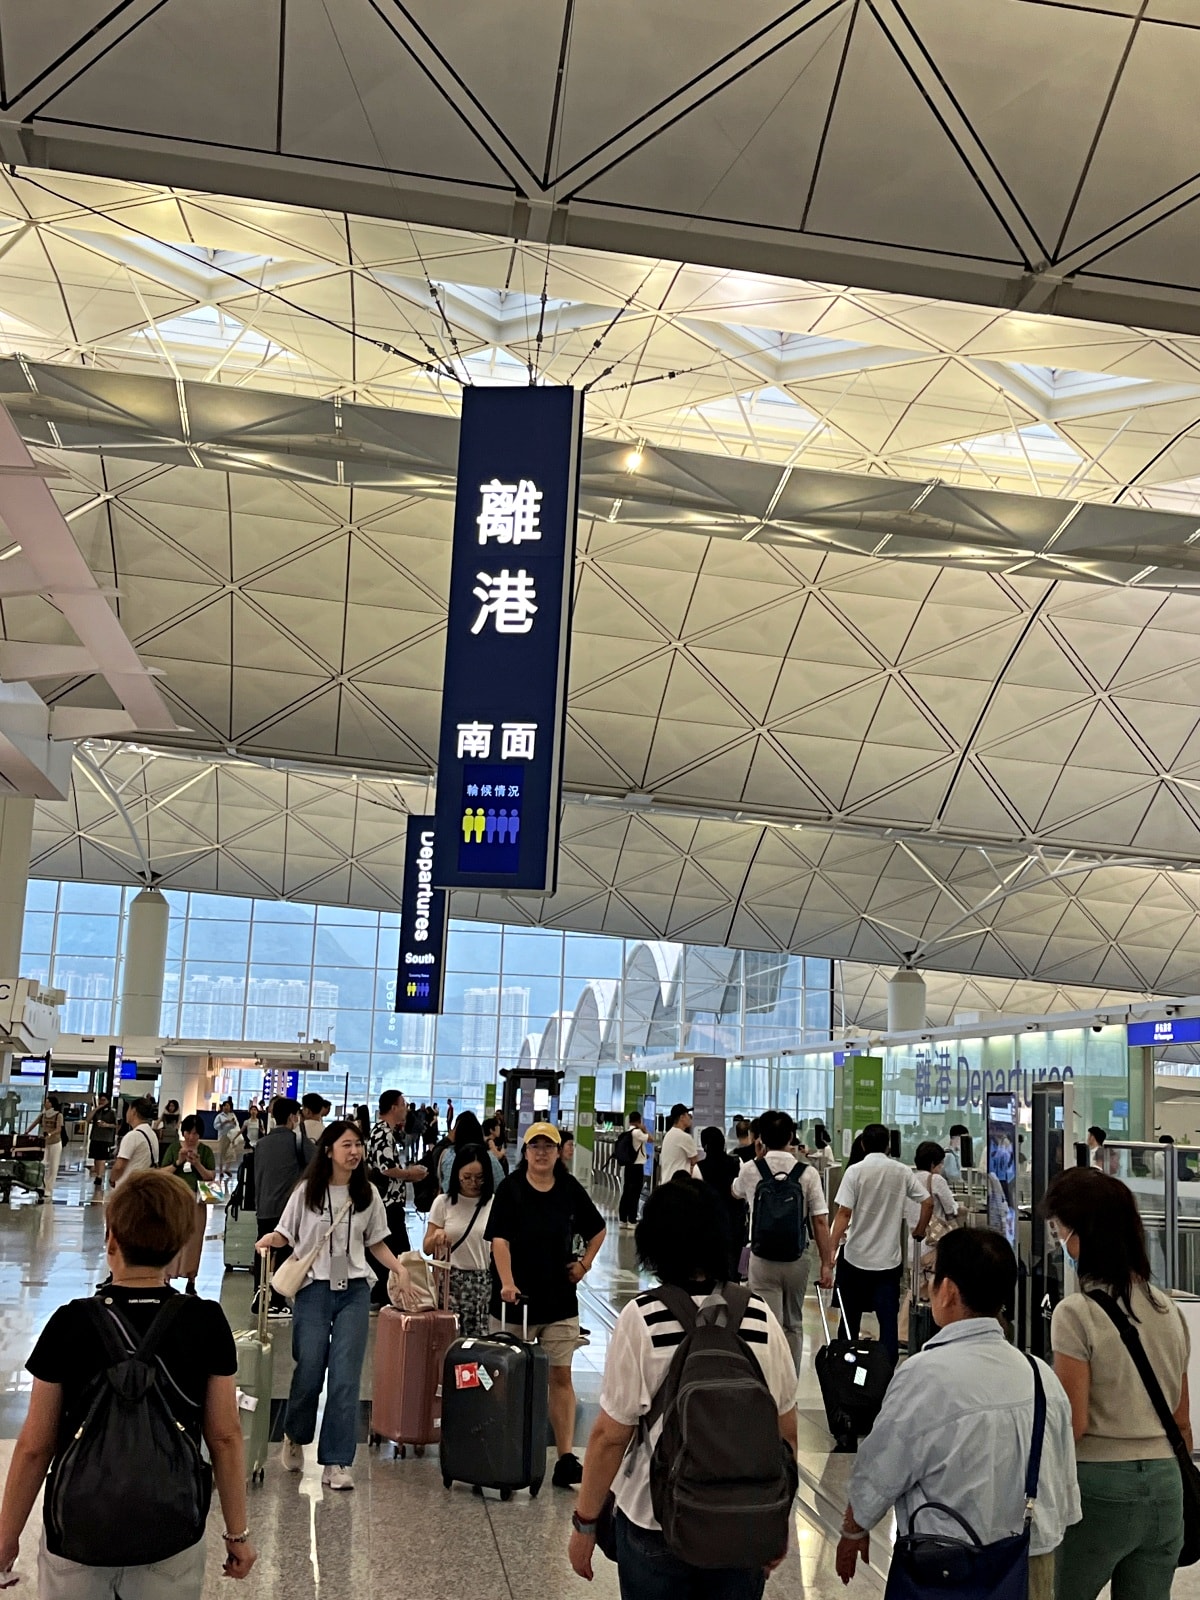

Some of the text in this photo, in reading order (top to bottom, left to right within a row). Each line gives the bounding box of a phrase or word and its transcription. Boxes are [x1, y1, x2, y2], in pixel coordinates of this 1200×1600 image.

[471, 478, 543, 635] 離港
[457, 720, 538, 760] 南面
[405, 951, 435, 964] South
[915, 1047, 951, 1107] 離港
